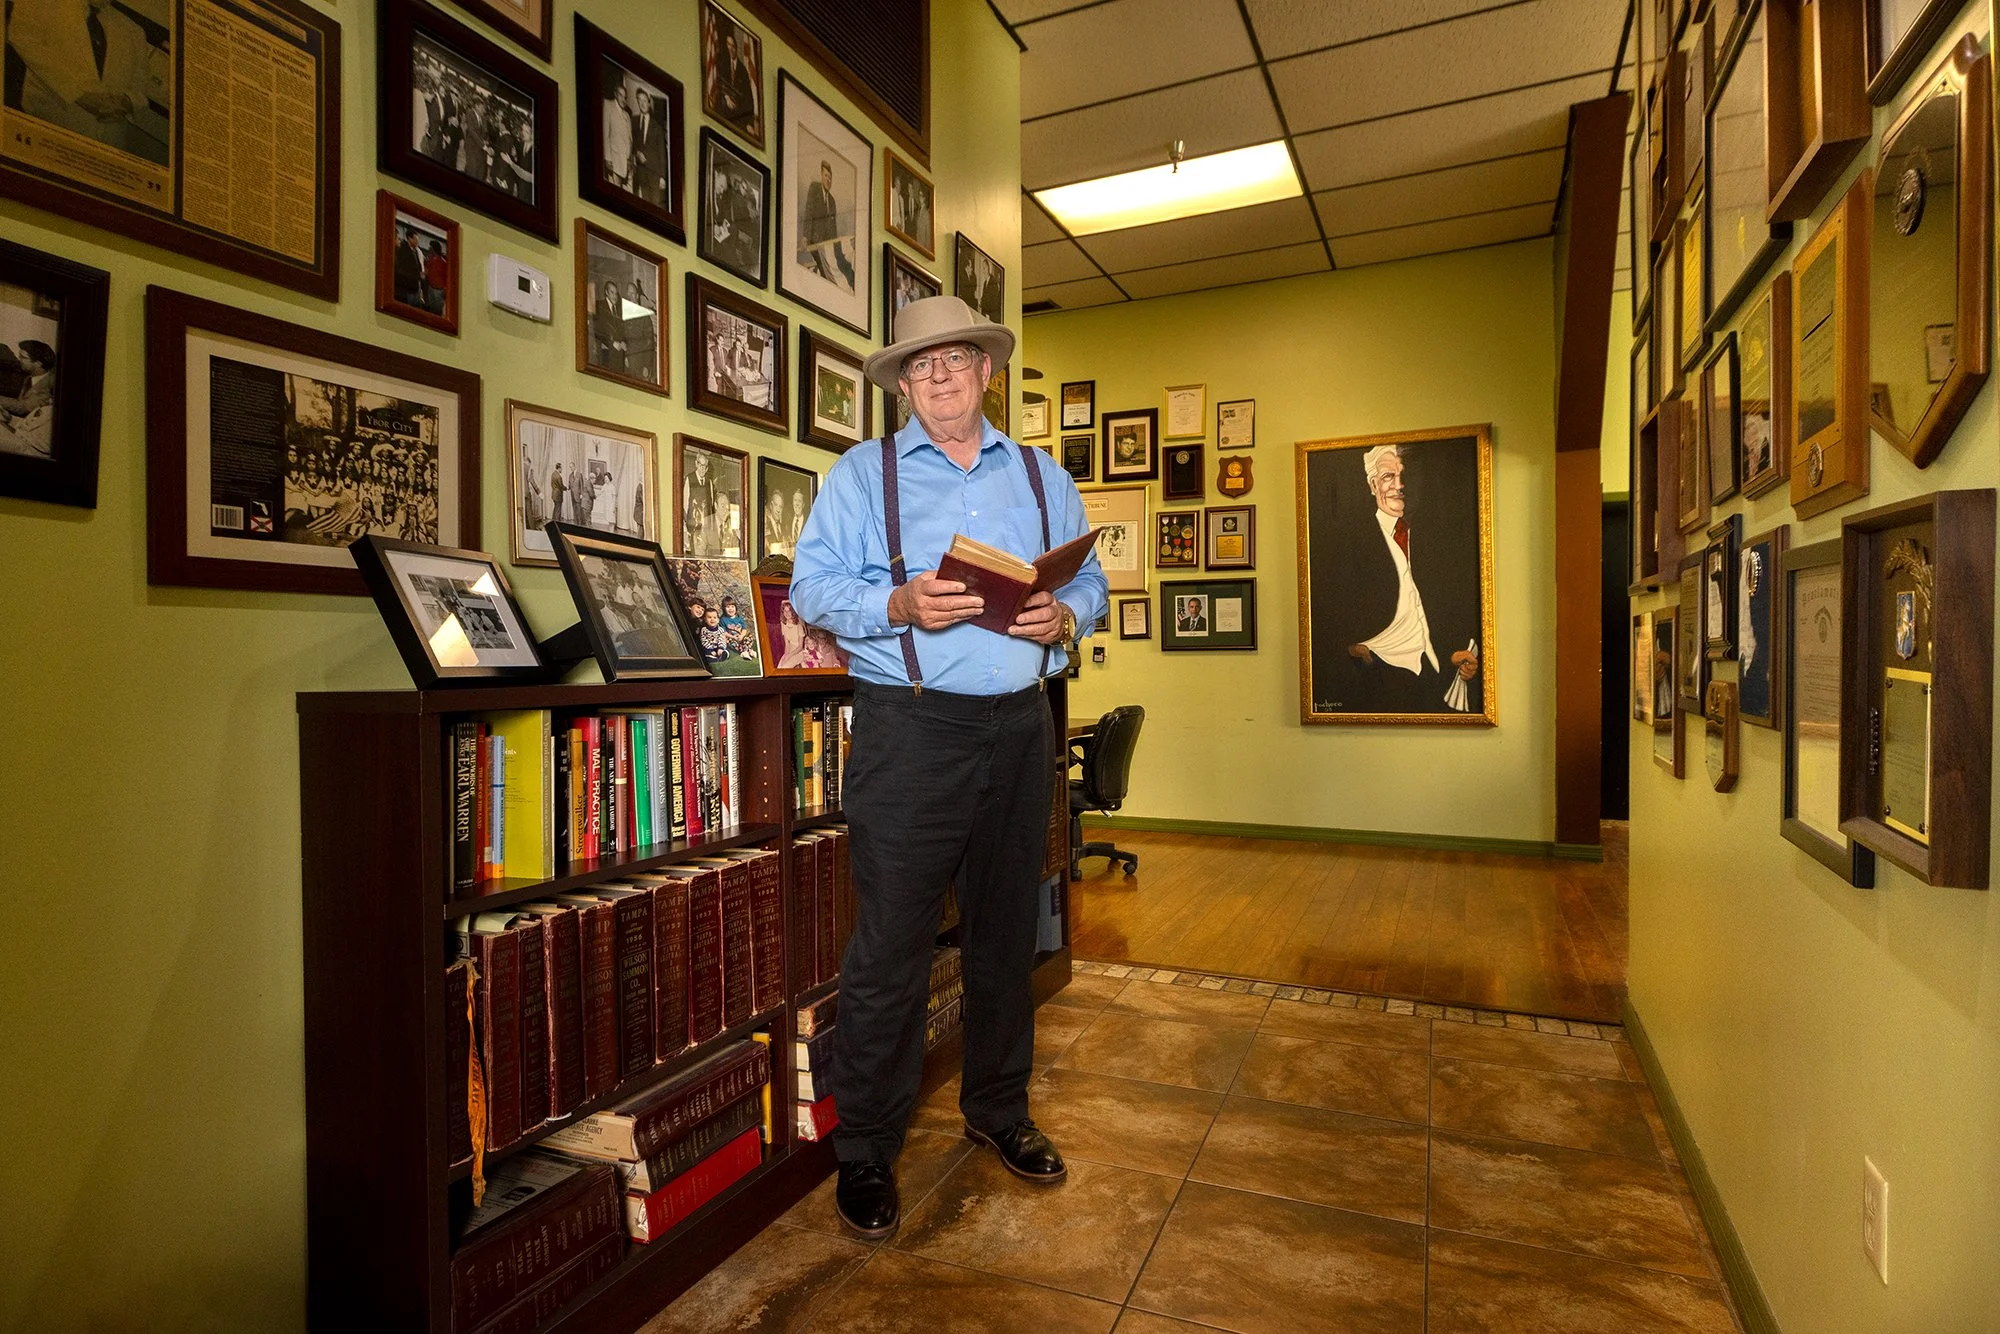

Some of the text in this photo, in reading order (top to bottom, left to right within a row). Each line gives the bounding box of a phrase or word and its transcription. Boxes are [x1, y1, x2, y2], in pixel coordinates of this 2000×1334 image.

[366, 415, 414, 433] YBOR CITY
[1088, 502, 1107, 511] TRIBUNE
[656, 720, 664, 738] THE
[657, 739, 665, 772] ADULT
[671, 738, 682, 783] GOVERNING
[458, 758, 470, 842] EARL WARREN
[592, 748, 601, 834] MAL PRACTICE
[731, 779, 739, 807] Agenda
[673, 785, 684, 823] AMERICA
[575, 795, 584, 854] Streetwalker
[752, 866, 778, 879] TAMPA
[722, 875, 748, 889] TAMPA
[758, 888, 774, 896] 1958
[656, 896, 686, 910] TAMPA
[727, 899, 742, 909] 1957
[621, 907, 647, 922] TAMPA
[662, 922, 681, 932] 1957
[623, 952, 647, 968] WILSON
[629, 978, 641, 989] CO.
[582, 1118, 599, 1126] LARKE
[585, 1125, 603, 1135] AGENCY
[649, 1116, 659, 1145] TAMPA
[534, 1238, 542, 1264] TITLE
[540, 1225, 550, 1266] COMPANY
[525, 1239, 533, 1274] ESTATE
[496, 1261, 504, 1288] 1973
